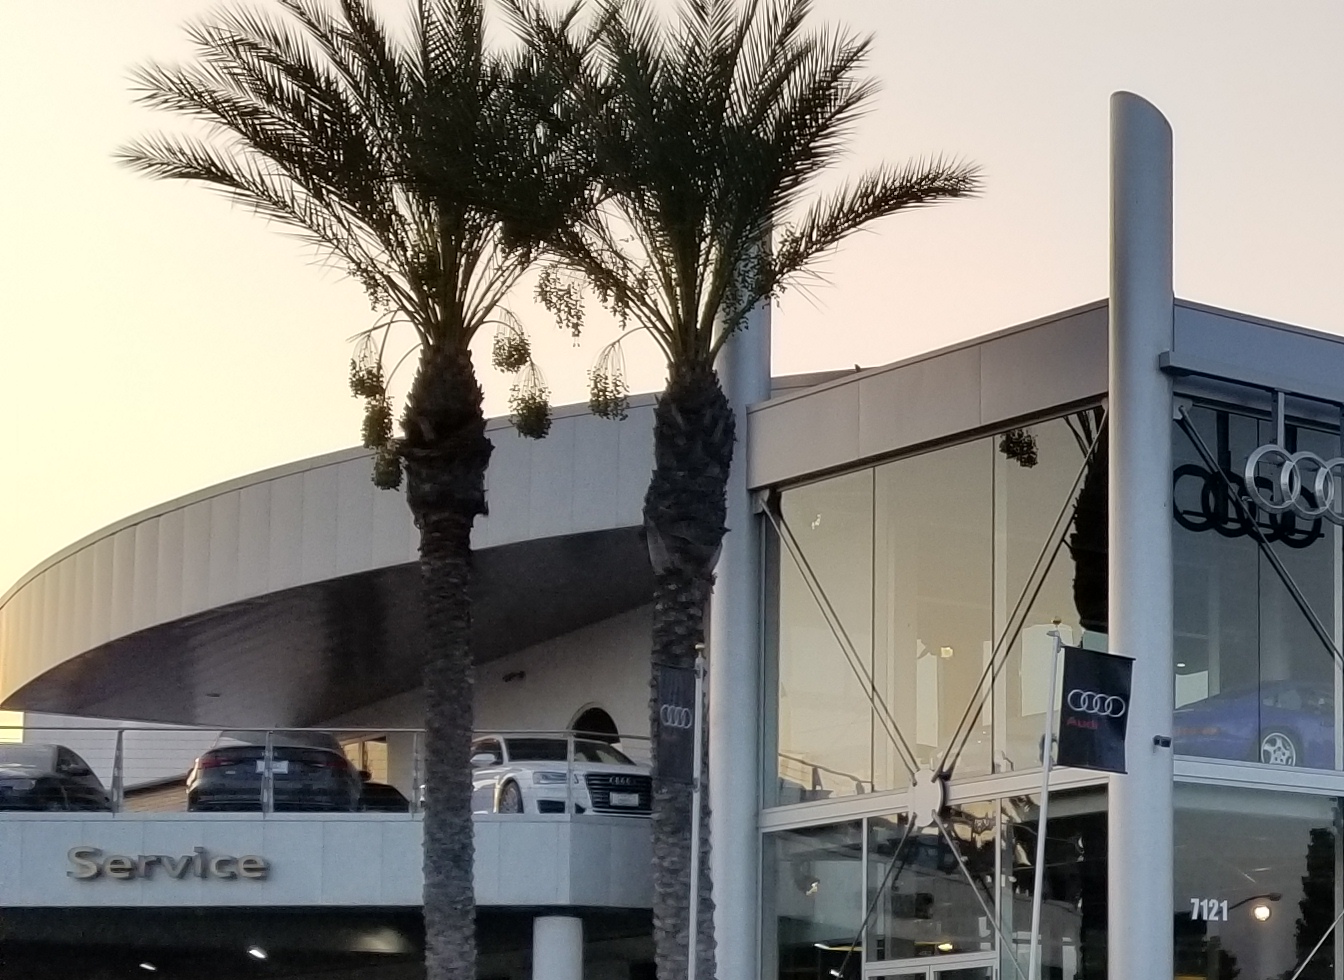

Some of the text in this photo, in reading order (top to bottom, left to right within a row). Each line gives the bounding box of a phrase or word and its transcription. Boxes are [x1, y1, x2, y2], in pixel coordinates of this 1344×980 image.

[1066, 716, 1100, 730] Audi
[66, 845, 271, 881] Service
[1190, 897, 1228, 922] 7121
